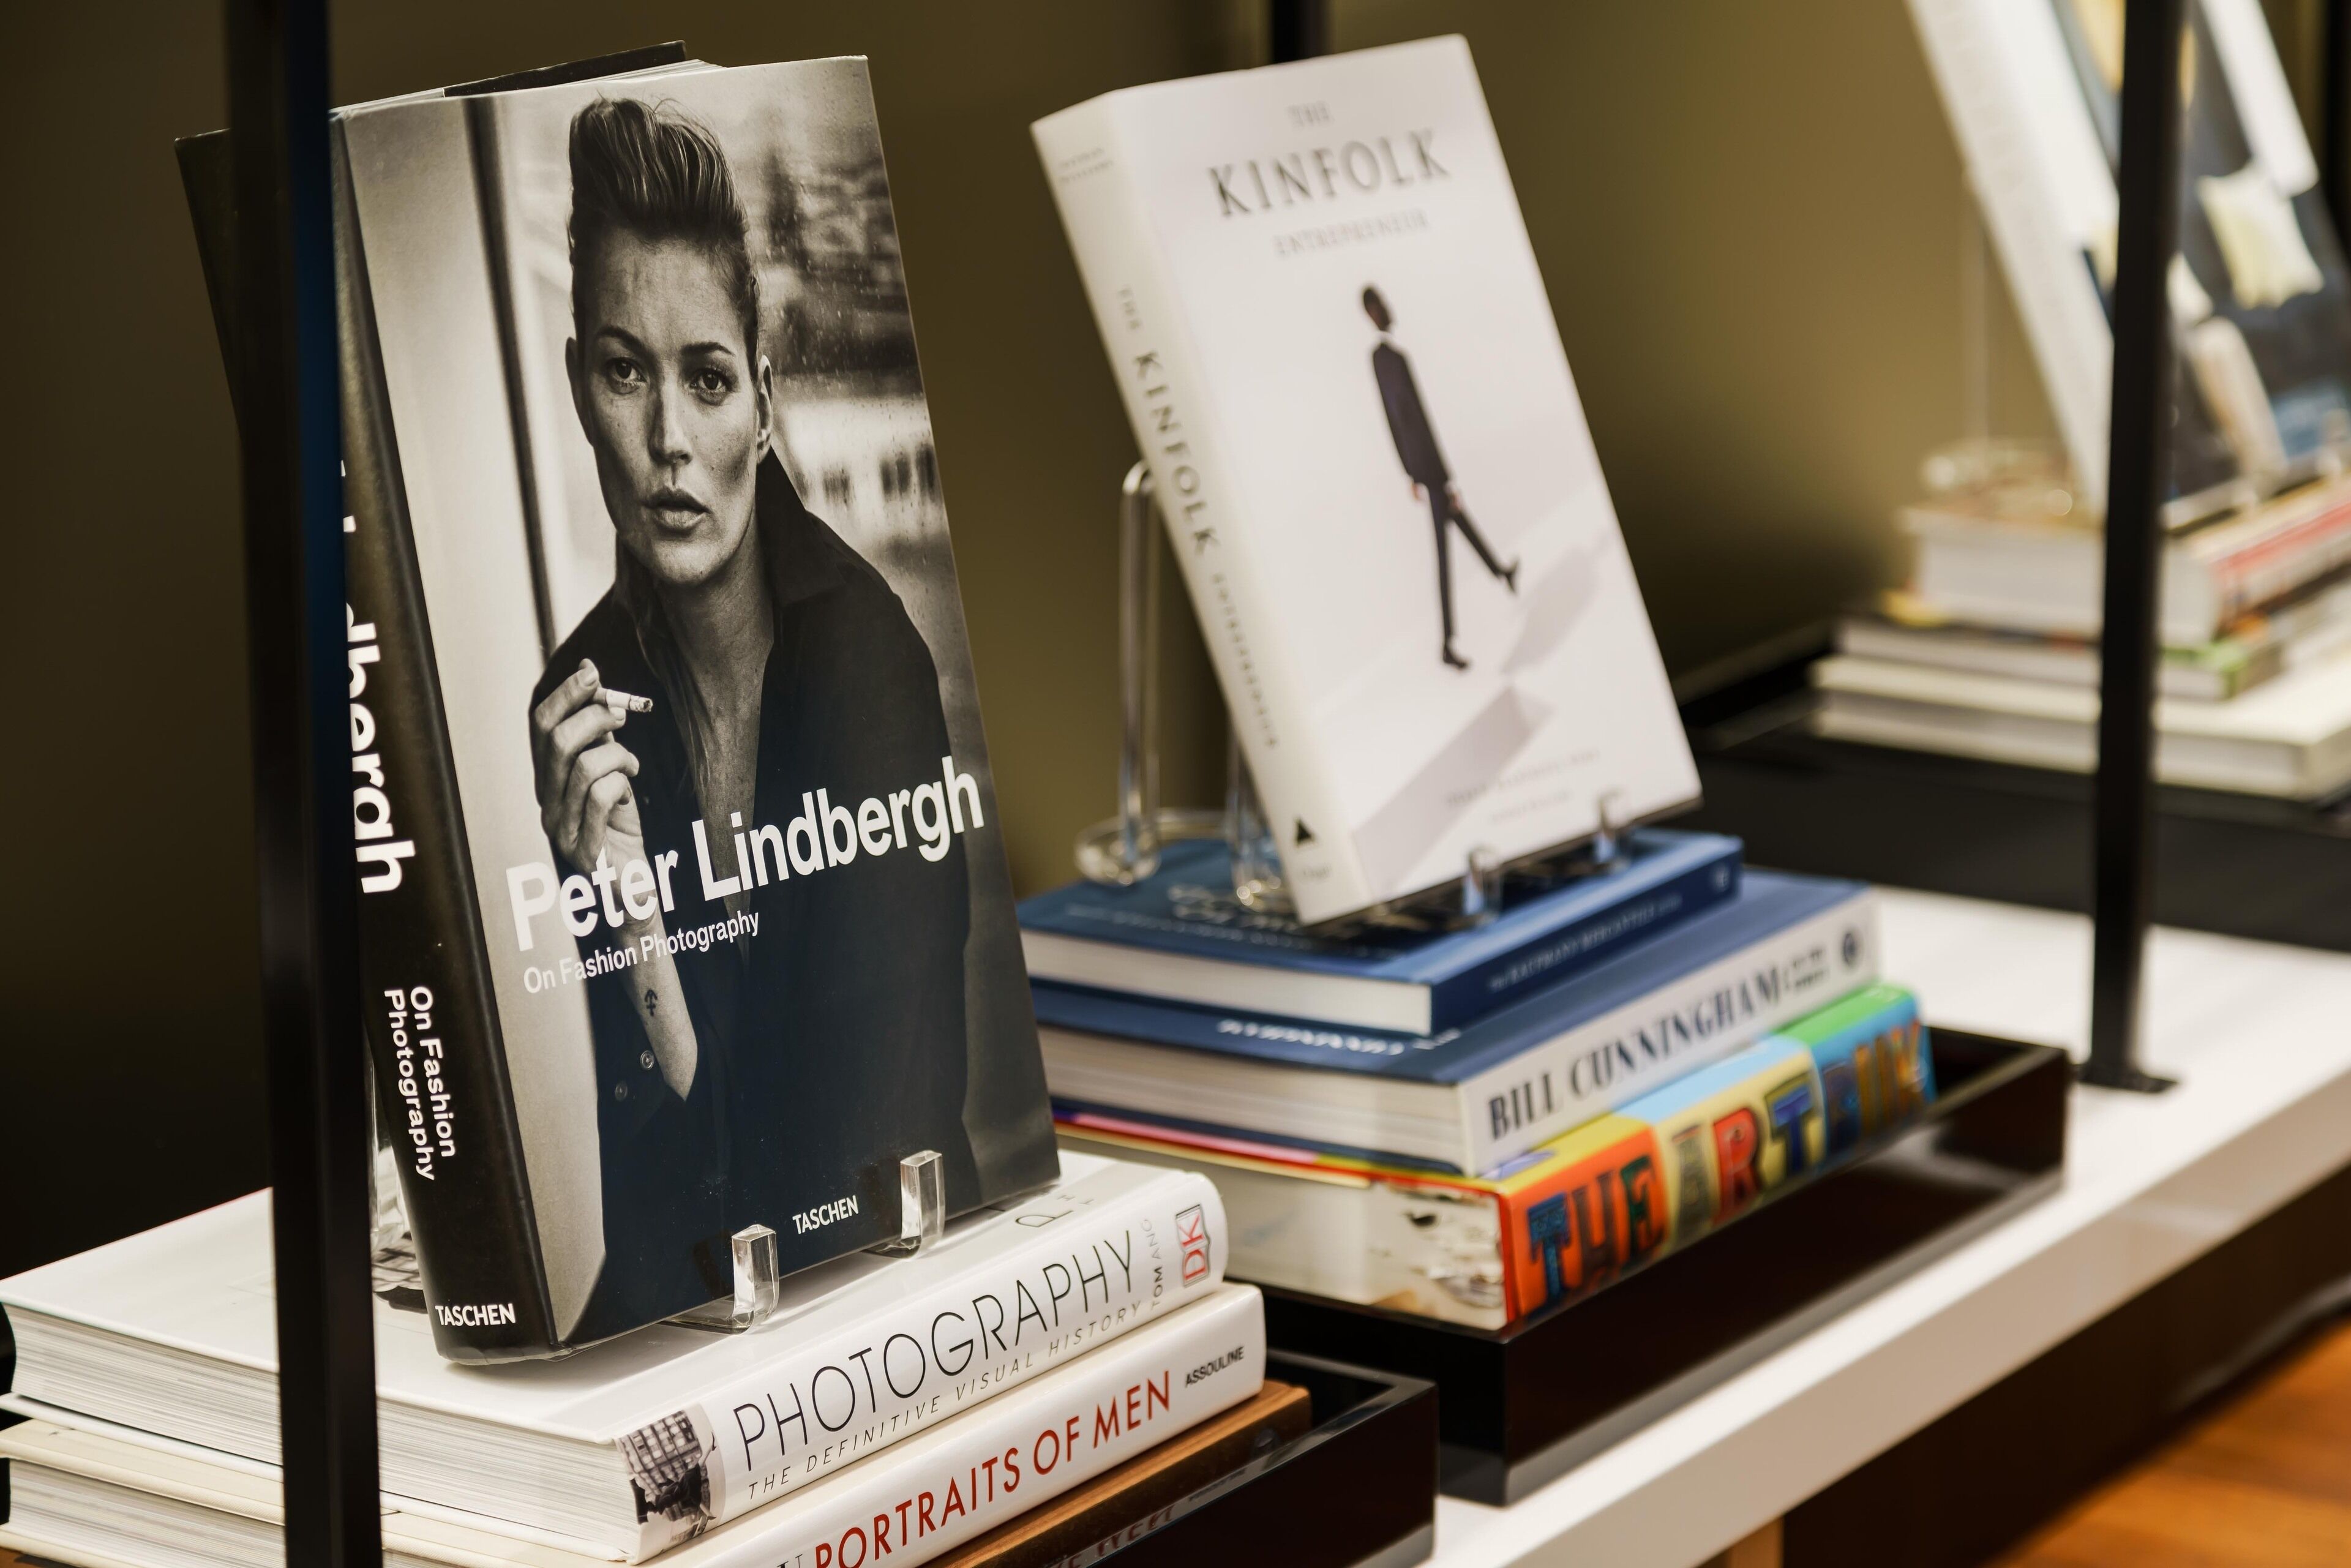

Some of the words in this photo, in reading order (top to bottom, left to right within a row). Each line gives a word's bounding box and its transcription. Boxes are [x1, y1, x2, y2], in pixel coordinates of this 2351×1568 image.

[1209, 129, 1451, 216] KINFOLK
[1134, 351, 1221, 553] KINFOLK
[505, 844, 678, 951] Peter
[692, 756, 984, 901] Lindbergh
[410, 986, 433, 1031] On
[523, 966, 556, 994] On
[560, 945, 637, 985] Fashion
[640, 910, 760, 962] Photography
[384, 988, 435, 1181] Photography
[420, 1037, 456, 1158] Fashion
[1488, 1070, 1556, 1141] BILL
[1569, 962, 1781, 1098] CUNNINGHAM
[793, 1195, 859, 1235] TASCHEN
[1179, 1214, 1207, 1281] DK
[1527, 1153, 1665, 1310] THE
[435, 1303, 516, 1326] TASCHEN
[732, 1230, 1131, 1471] PHOTOGRAPHY
[1152, 1266, 1163, 1309] TOM
[749, 1466, 790, 1499] THE
[807, 1395, 940, 1472] DEFINITIVE
[956, 1352, 1033, 1401] VISUAL
[1048, 1300, 1141, 1357] HISTORY
[814, 1447, 1021, 1568] PORTRAITS
[1033, 1416, 1079, 1476] OF
[1092, 1370, 1170, 1449] MEN
[1185, 1346, 1245, 1389] ASSOULINE
